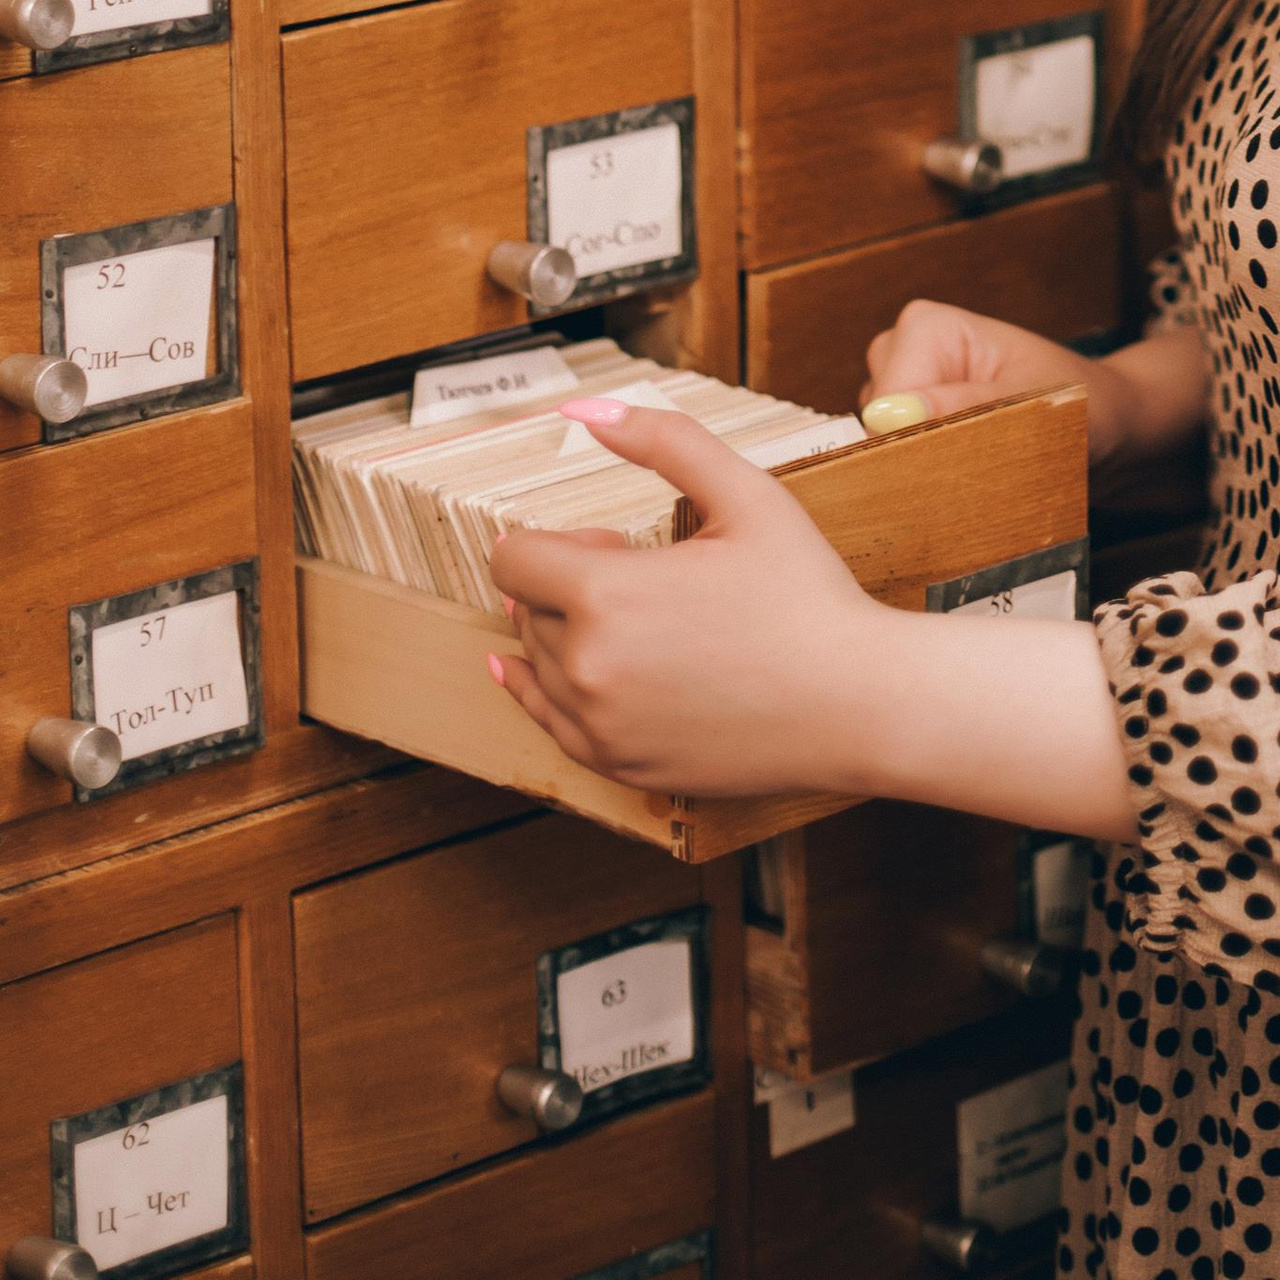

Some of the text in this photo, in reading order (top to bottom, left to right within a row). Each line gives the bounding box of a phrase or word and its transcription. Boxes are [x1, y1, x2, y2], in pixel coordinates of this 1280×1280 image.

[97, 262, 127, 290] 52
[990, 590, 1014, 617] 58
[139, 615, 167, 647] 57
[111, 682, 216, 736] Тол-Туп
[122, 1122, 150, 1151] 62
[97, 1206, 119, 1235] Ц
[147, 1190, 191, 1215] Чет
